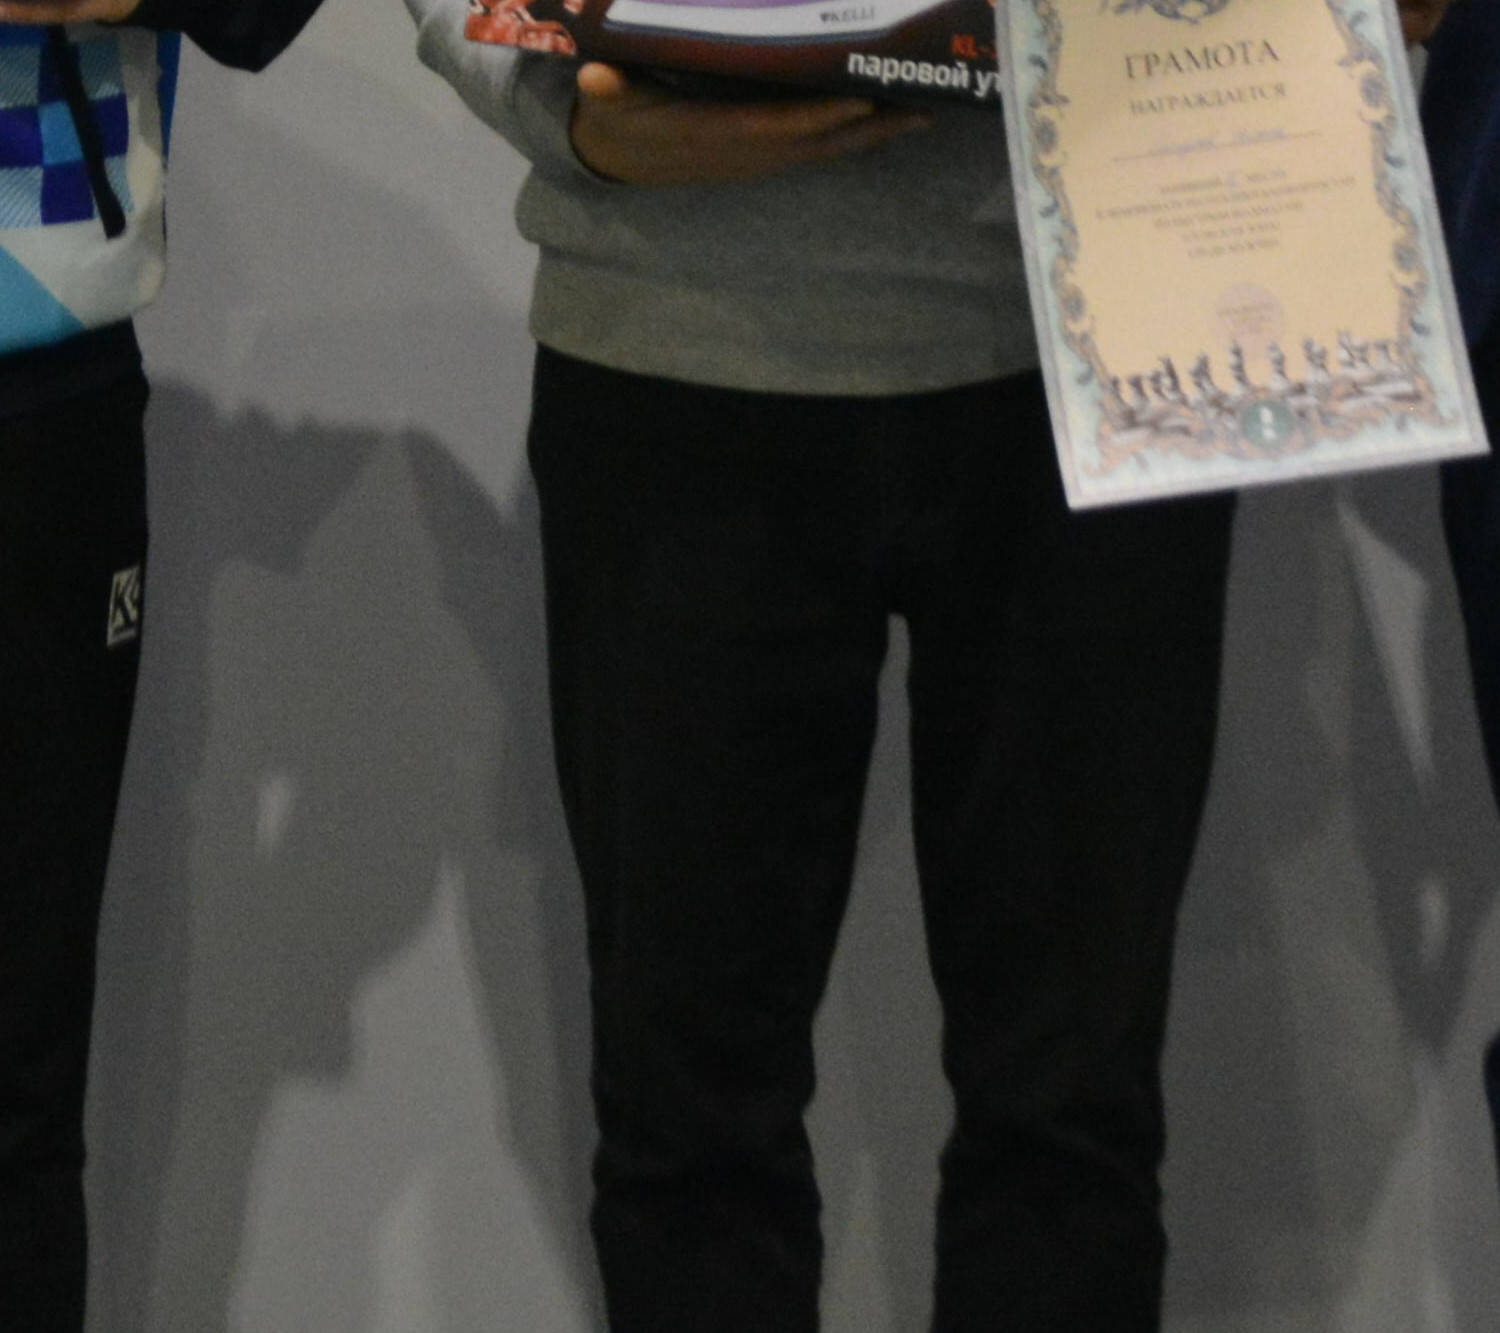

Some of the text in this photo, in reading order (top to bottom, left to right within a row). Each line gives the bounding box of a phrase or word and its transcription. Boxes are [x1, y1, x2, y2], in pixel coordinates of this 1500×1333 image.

[848, 52, 969, 89] паровой
[1124, 39, 1280, 80] ГРАМОТА
[1130, 83, 1287, 116] НАГРАЖДАЕТСЯ
